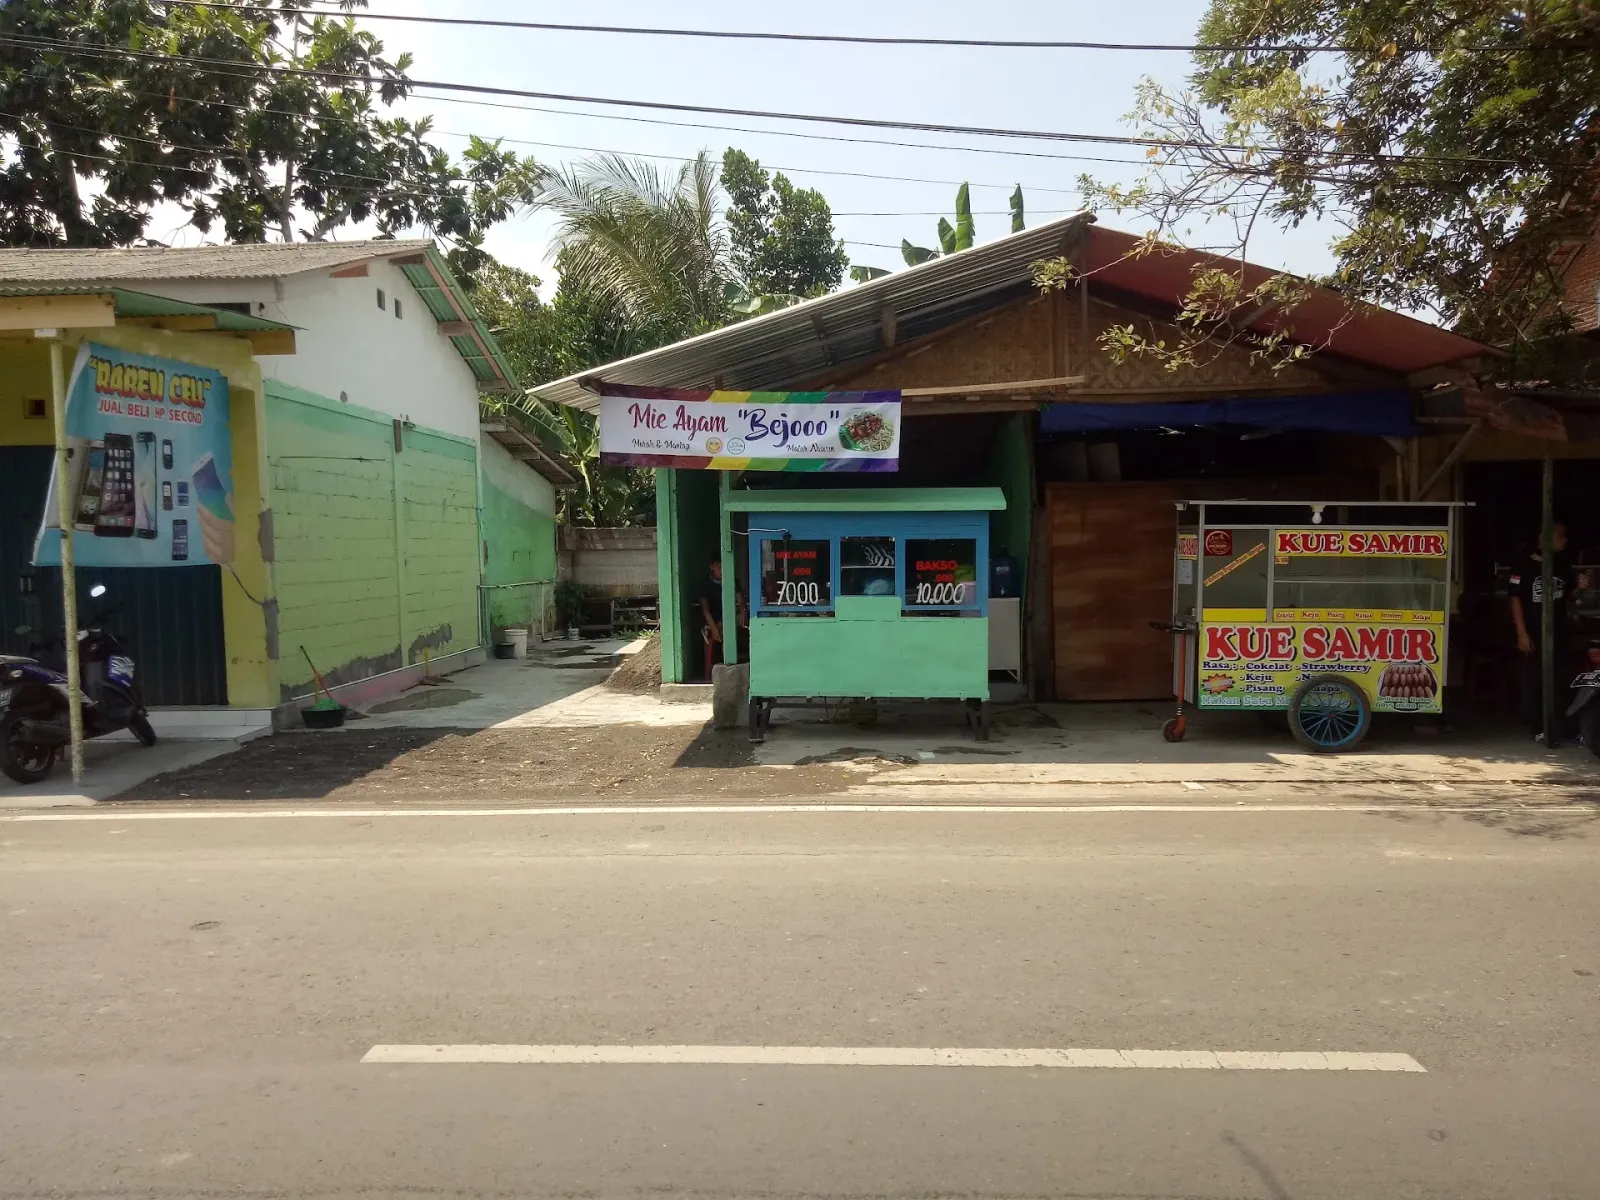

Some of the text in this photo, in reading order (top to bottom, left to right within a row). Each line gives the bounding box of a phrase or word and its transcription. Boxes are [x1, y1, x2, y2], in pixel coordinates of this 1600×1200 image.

[99, 399, 202, 424] JUAL BELI HP SECOND
[628, 403, 840, 447] Mie Ayam "Bejooo"
[1278, 532, 1446, 555] KUE SAMIR
[915, 560, 958, 571] BAKSO
[776, 581, 819, 605] 7000
[1205, 626, 1438, 663] KUE SAMIR
[1203, 661, 1230, 669] Rasa
[1301, 662, 1370, 673] Strawberry
[1201, 695, 1240, 705] Makan
